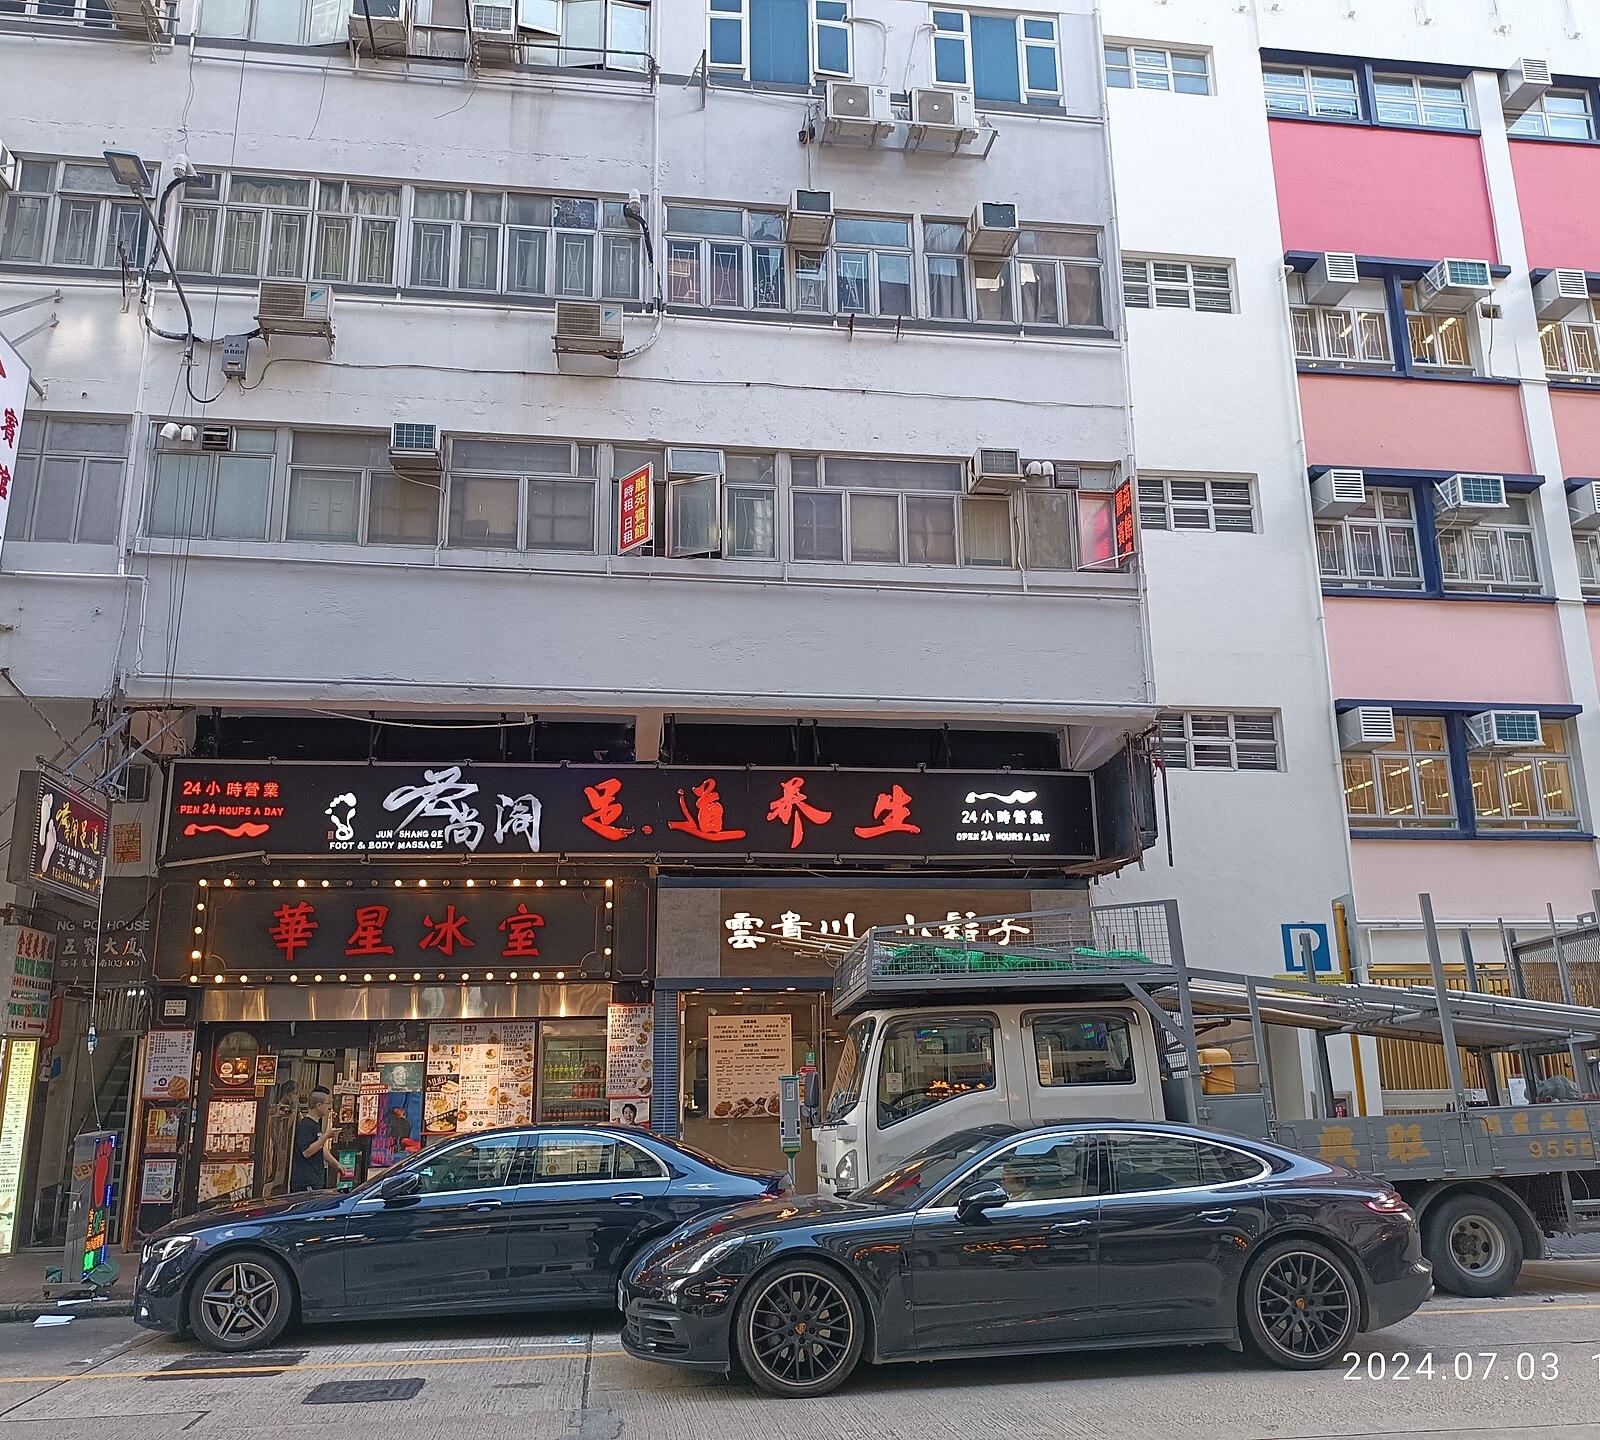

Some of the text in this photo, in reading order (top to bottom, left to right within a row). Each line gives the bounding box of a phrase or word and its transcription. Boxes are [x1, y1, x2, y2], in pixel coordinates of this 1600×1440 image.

[623, 515, 634, 545] 日租
[183, 781, 279, 798] 24小時營業
[202, 803, 216, 815] 24
[254, 808, 261, 816] A
[264, 807, 284, 816] DAY
[375, 830, 394, 839] JUN
[398, 829, 430, 838] SHANG
[956, 829, 1051, 842] OPEN 24 HOURS A DAY
[329, 840, 444, 850] FOOT & BODY MASSAGE
[57, 921, 76, 931] NG
[107, 920, 150, 931] HOUSE
[267, 901, 545, 960] 華星冰室
[1289, 928, 1320, 967] P
